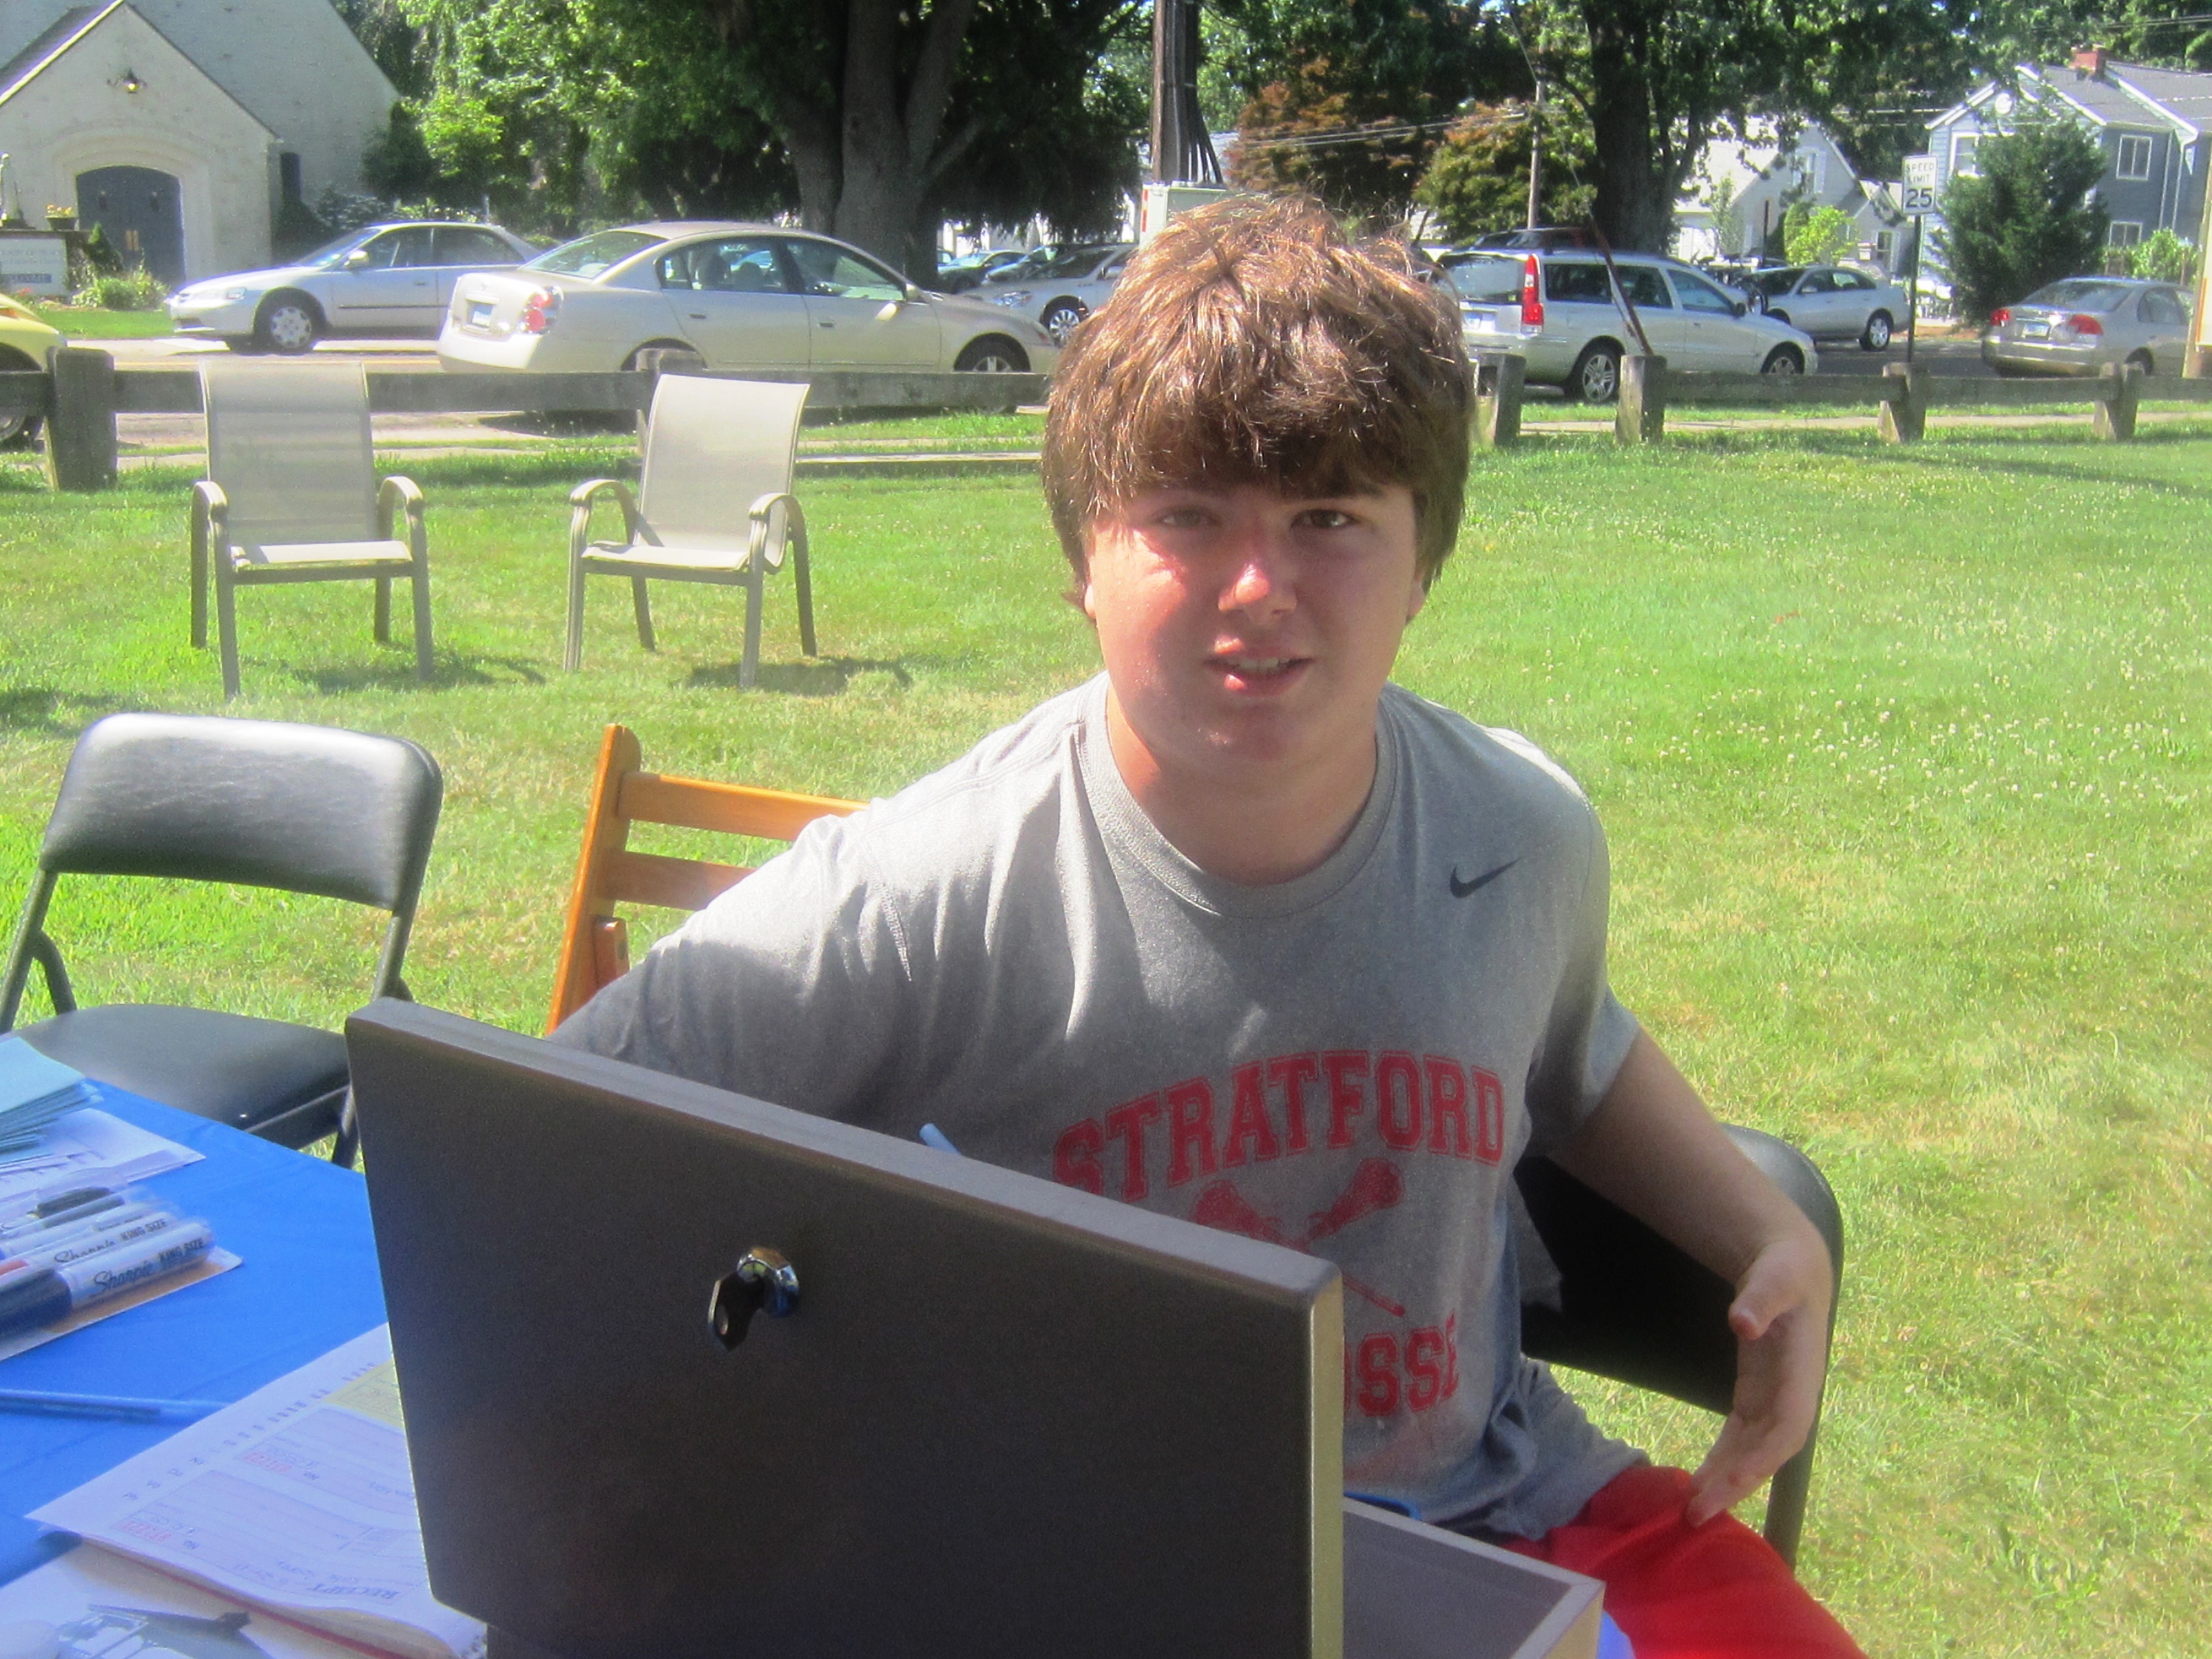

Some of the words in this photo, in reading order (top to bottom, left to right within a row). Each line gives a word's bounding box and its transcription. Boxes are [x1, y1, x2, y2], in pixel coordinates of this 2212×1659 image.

[1906, 163, 1934, 173] SPEED
[1907, 174, 1931, 184] LIMIT
[1906, 187, 1932, 207] 25
[1053, 1049, 1505, 1203] STRATFORD
[119, 1226, 146, 1241] KING
[145, 1218, 167, 1233] SIZE
[92, 1259, 157, 1293] Sharpie
[158, 1247, 182, 1264] KING
[183, 1237, 205, 1252] SIZE
[306, 1583, 401, 1599] RECEIPT
